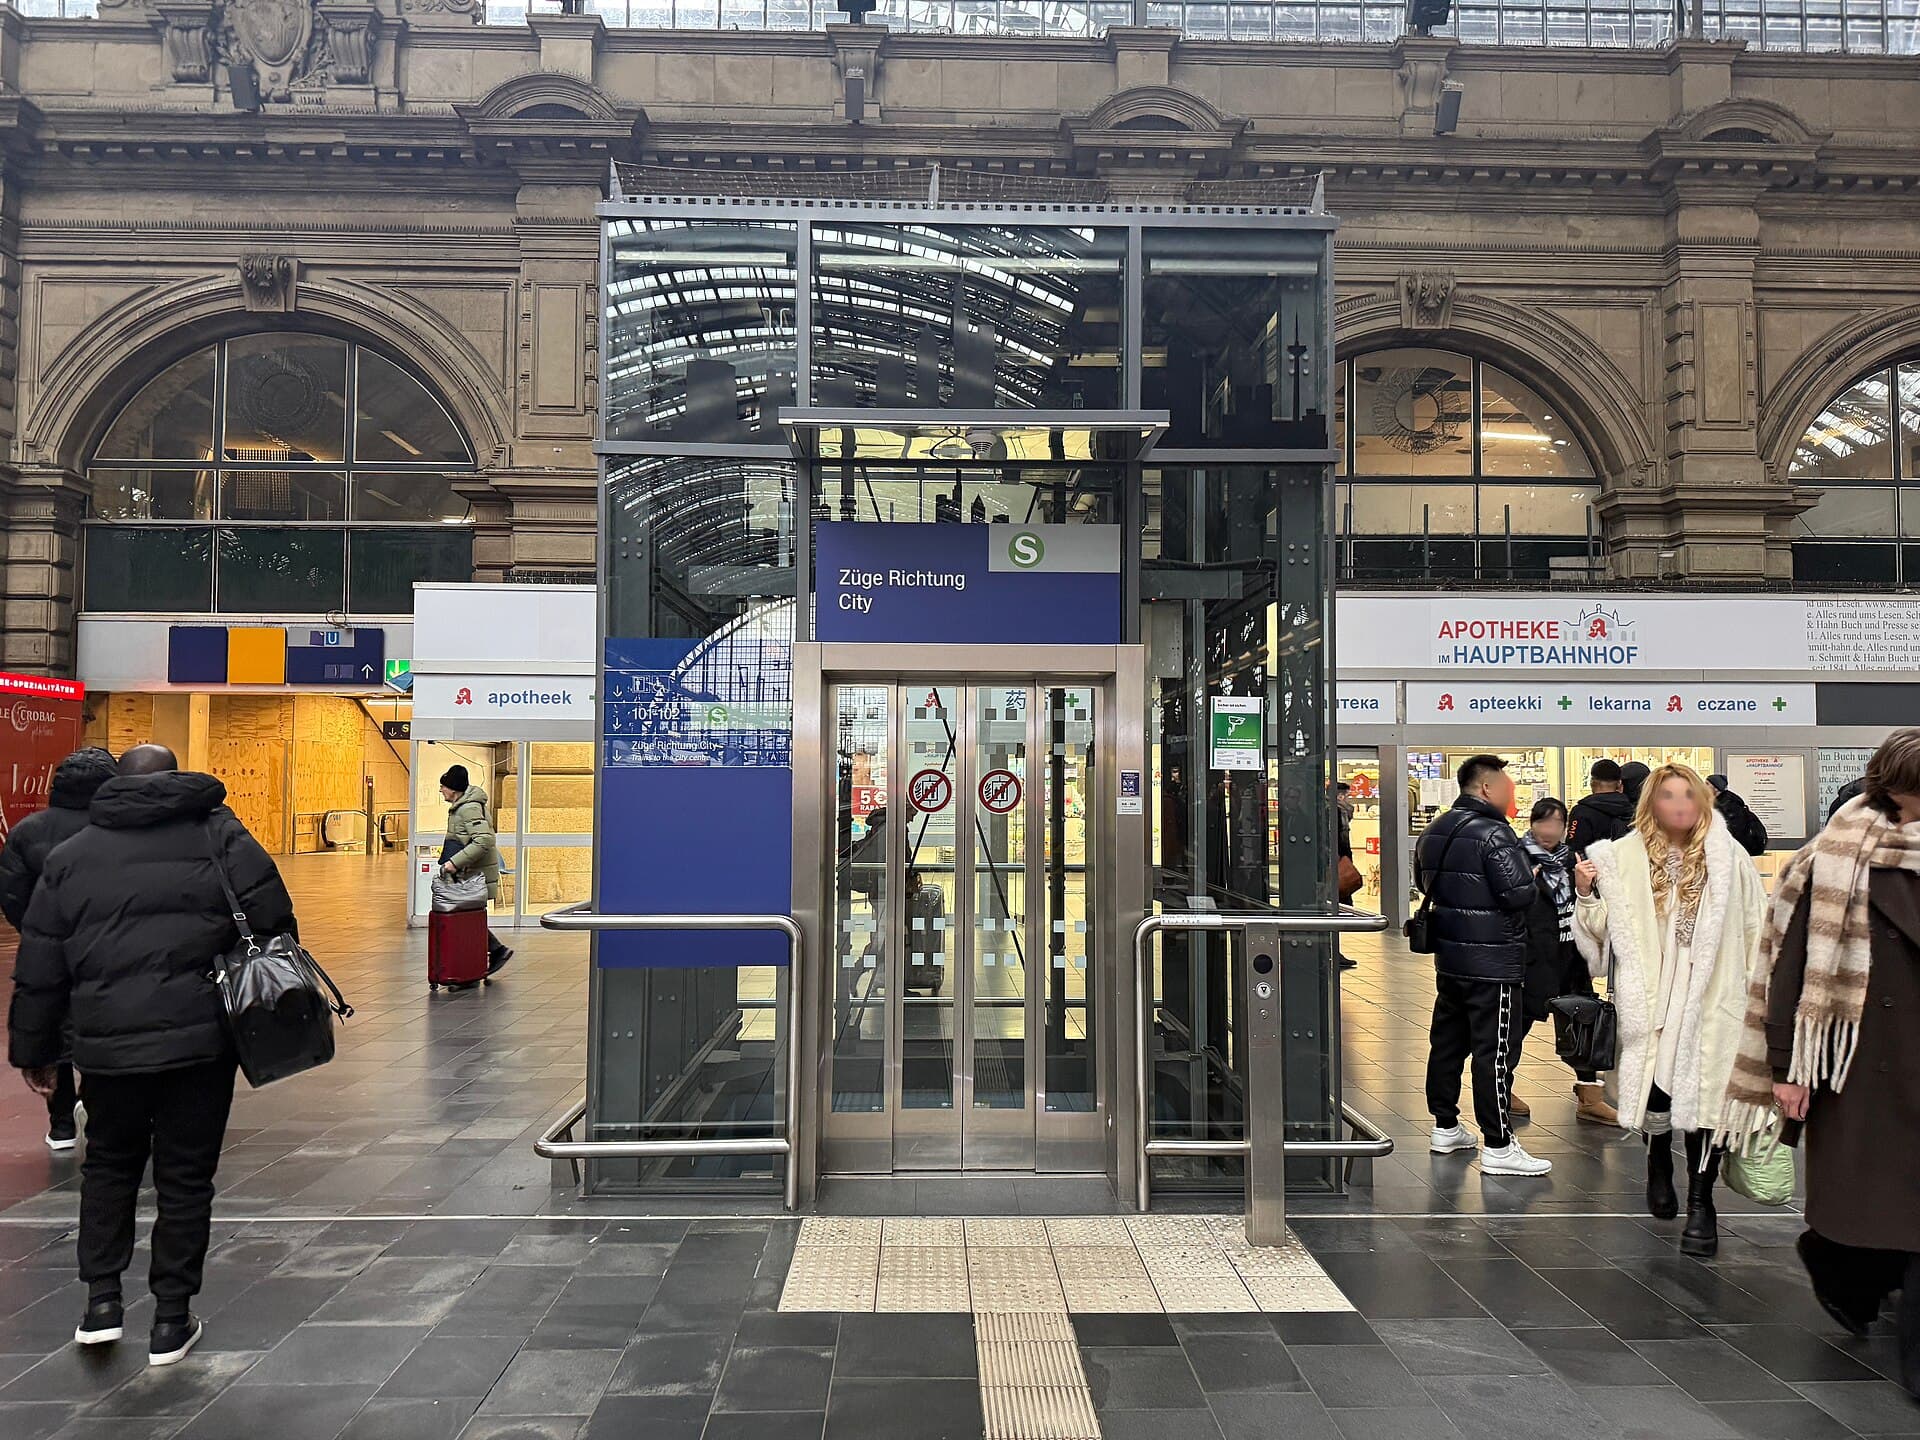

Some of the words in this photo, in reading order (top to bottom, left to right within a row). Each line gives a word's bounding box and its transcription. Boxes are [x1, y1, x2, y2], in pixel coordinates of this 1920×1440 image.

[838, 569, 883, 589] Züge
[889, 569, 966, 591] Richtung
[838, 594, 873, 613] City
[1816, 610, 1837, 619] Alles
[1438, 621, 1559, 639] APOTHEKE
[1816, 620, 1838, 628] Hahn
[1841, 620, 1862, 628] Buch
[1864, 620, 1880, 629] und
[1882, 621, 1908, 630] Presse
[328, 632, 338, 644] U
[1820, 632, 1840, 640] Alles
[1438, 654, 1450, 664] IM
[1453, 646, 1638, 664] HAUPTBAHNHOF
[1819, 653, 1850, 662] Schmitt
[1864, 654, 1885, 662] Hahn
[1888, 654, 1909, 662] Buch
[488, 690, 572, 706] apotheek
[1469, 696, 1542, 712] apteekki
[1589, 696, 1651, 710] lekarna
[1698, 700, 1757, 710] eczane
[631, 740, 654, 752] Züge
[658, 740, 698, 752] Richtung
[700, 740, 718, 752] City
[1834, 752, 1856, 760] Buch
[1568, 820, 1578, 838] vivo
